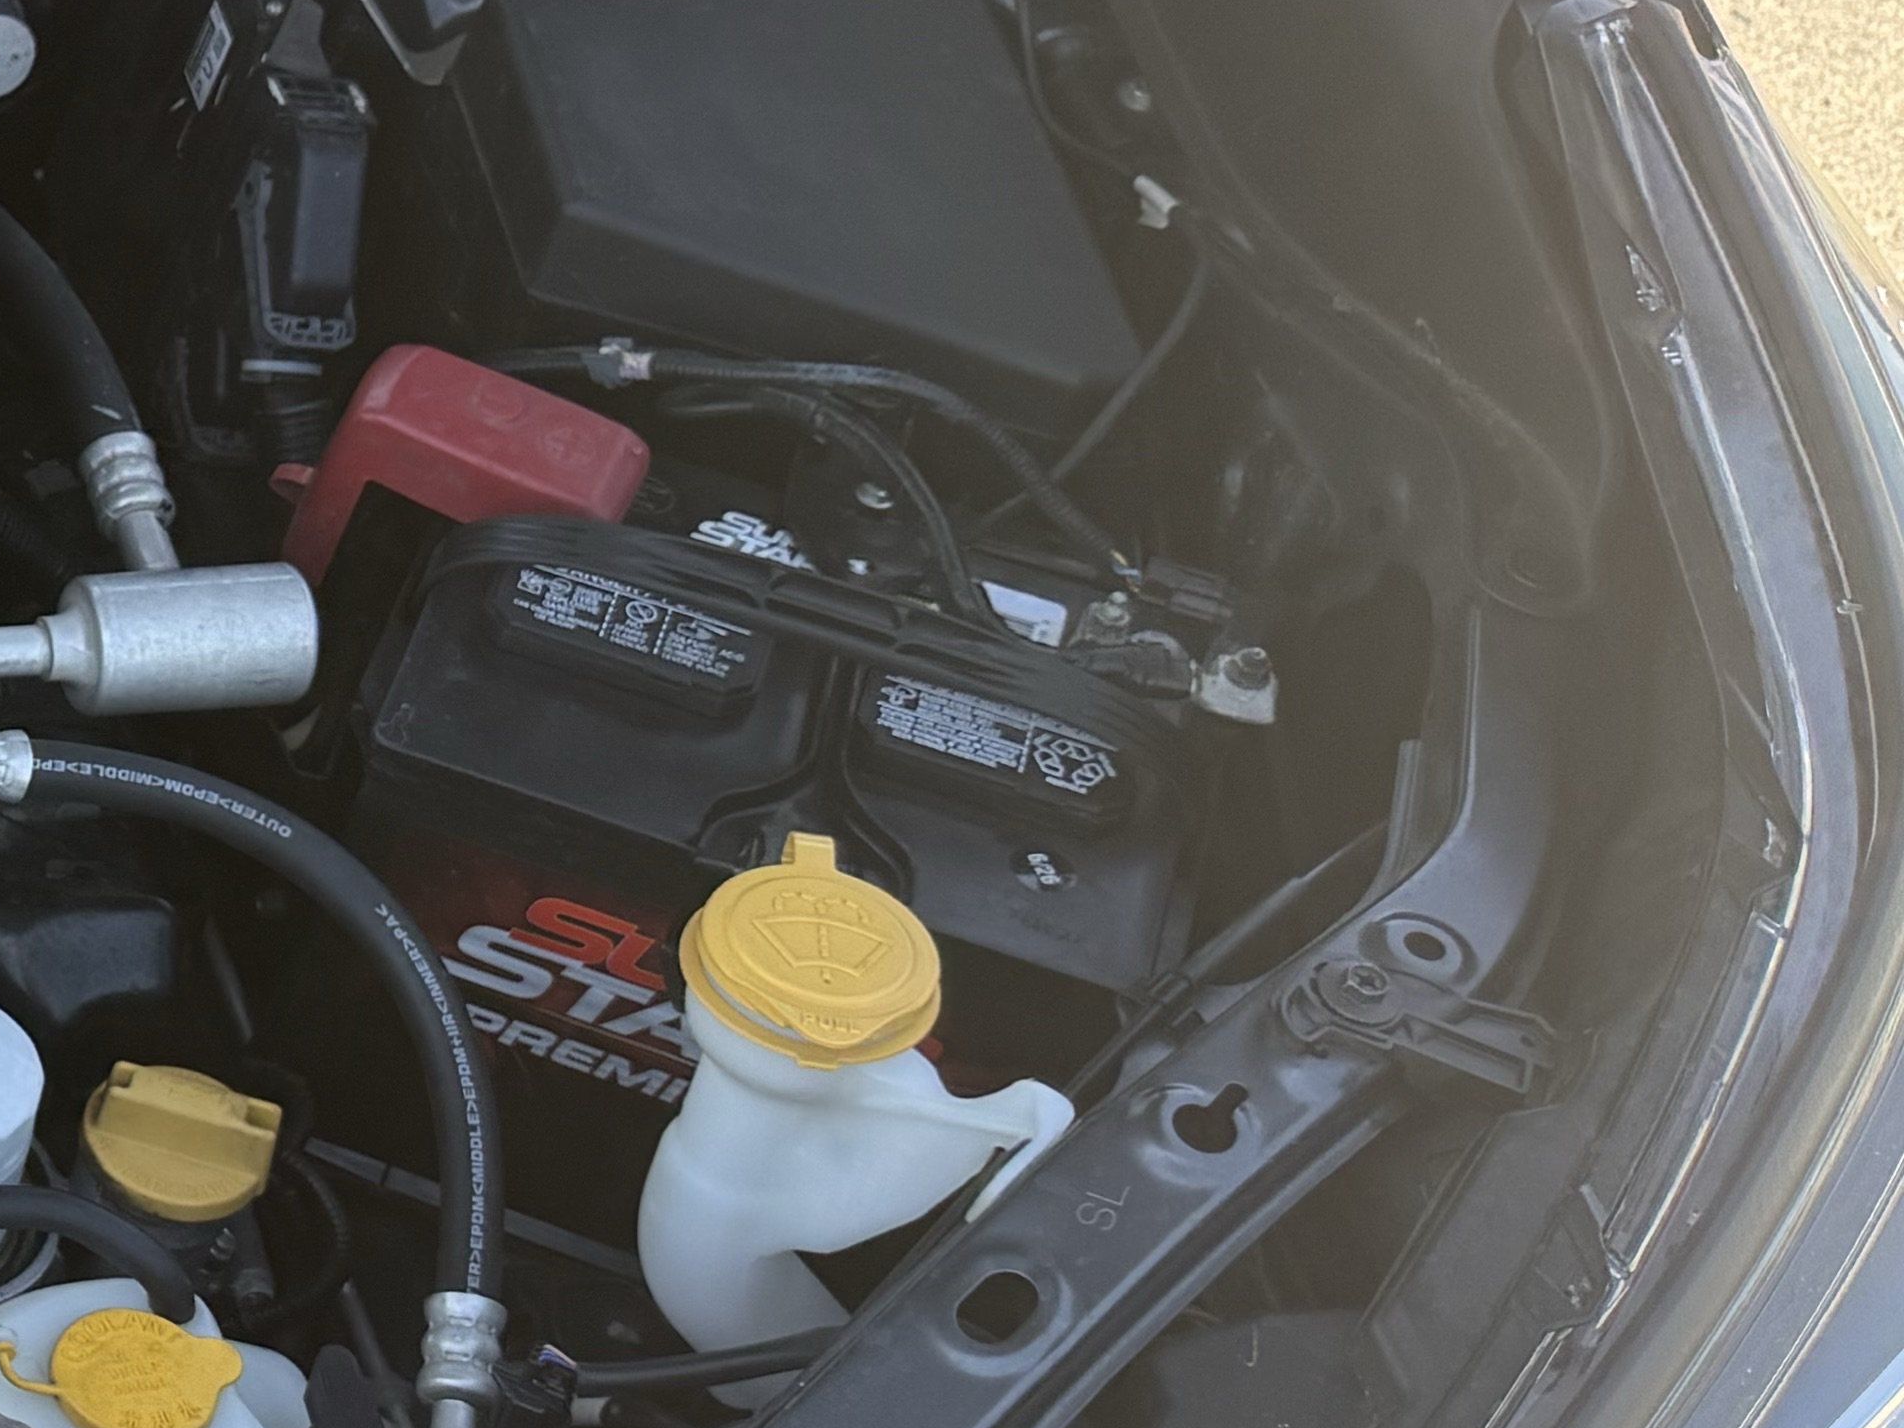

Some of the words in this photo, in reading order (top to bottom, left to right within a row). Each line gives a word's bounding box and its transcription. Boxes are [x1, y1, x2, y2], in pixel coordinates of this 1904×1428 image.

[799, 1010, 862, 1036] PULL
[374, 902, 485, 1292] ER>EPDM<MIDDLE>EPDM+IIR<INNER>PA<
[1075, 1185, 1131, 1231] SL
[60, 1312, 183, 1363] COOLANT
